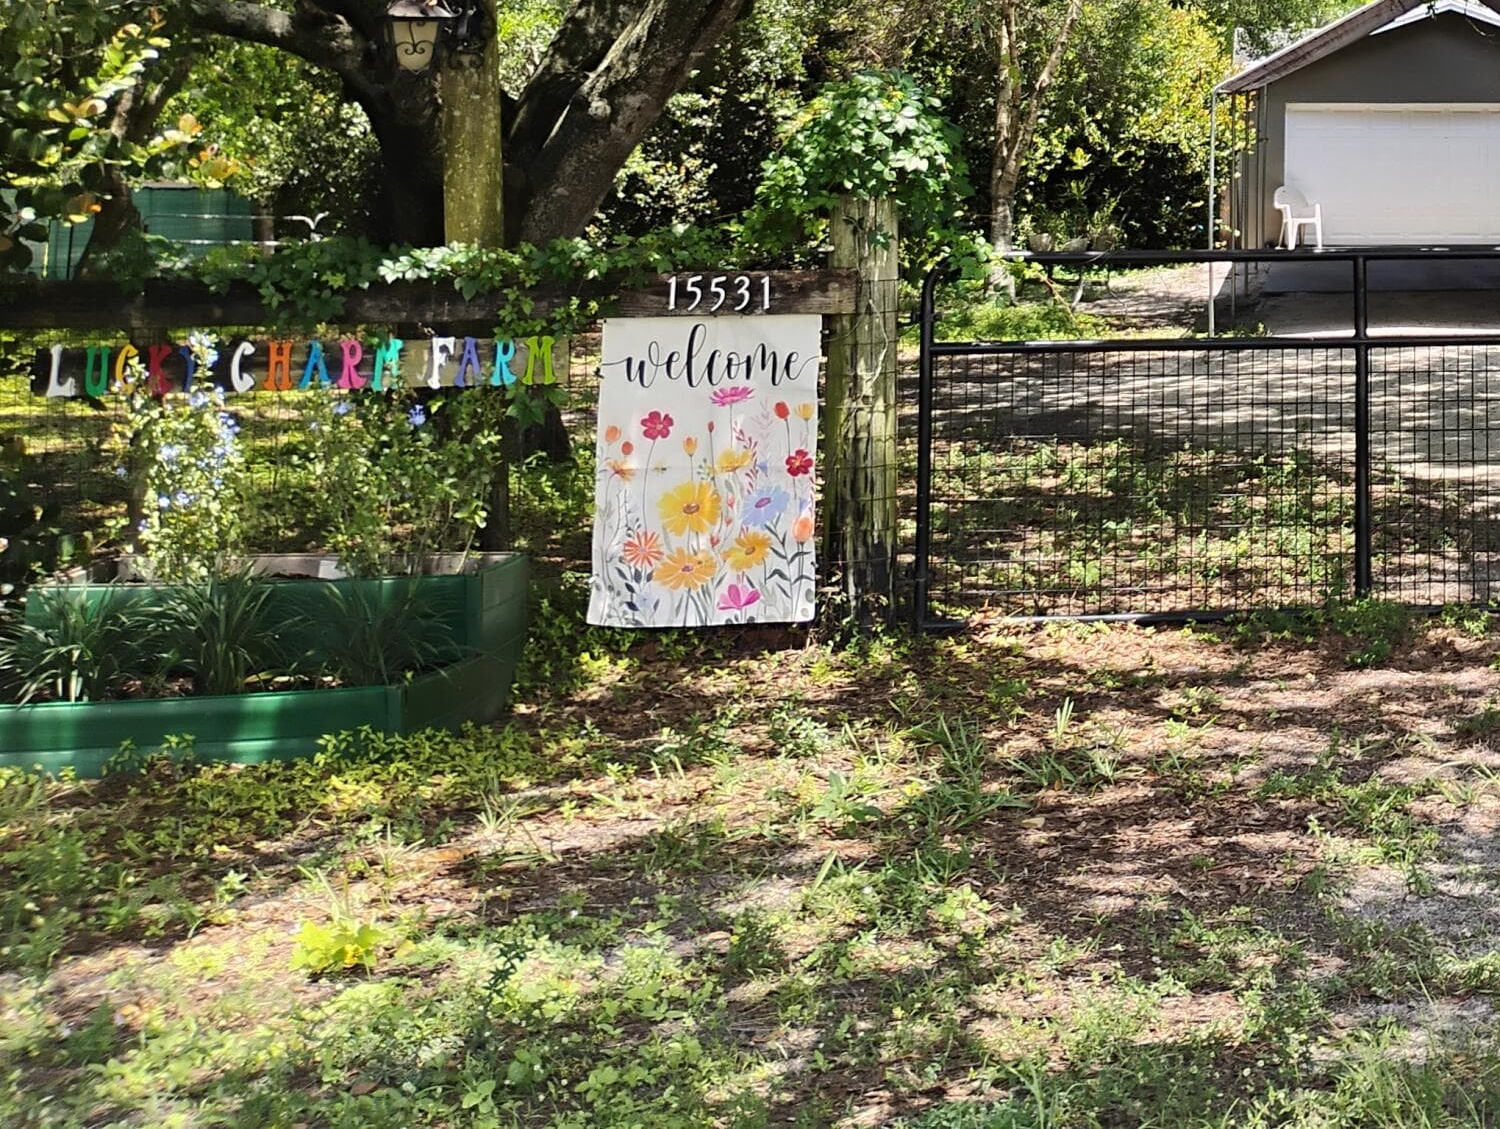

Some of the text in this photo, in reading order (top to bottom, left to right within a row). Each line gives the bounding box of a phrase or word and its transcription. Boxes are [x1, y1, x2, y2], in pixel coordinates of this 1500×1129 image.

[667, 275, 771, 312] 15531
[230, 338, 404, 393] CHARM
[428, 336, 557, 390] FARM
[602, 323, 818, 389] welcome
